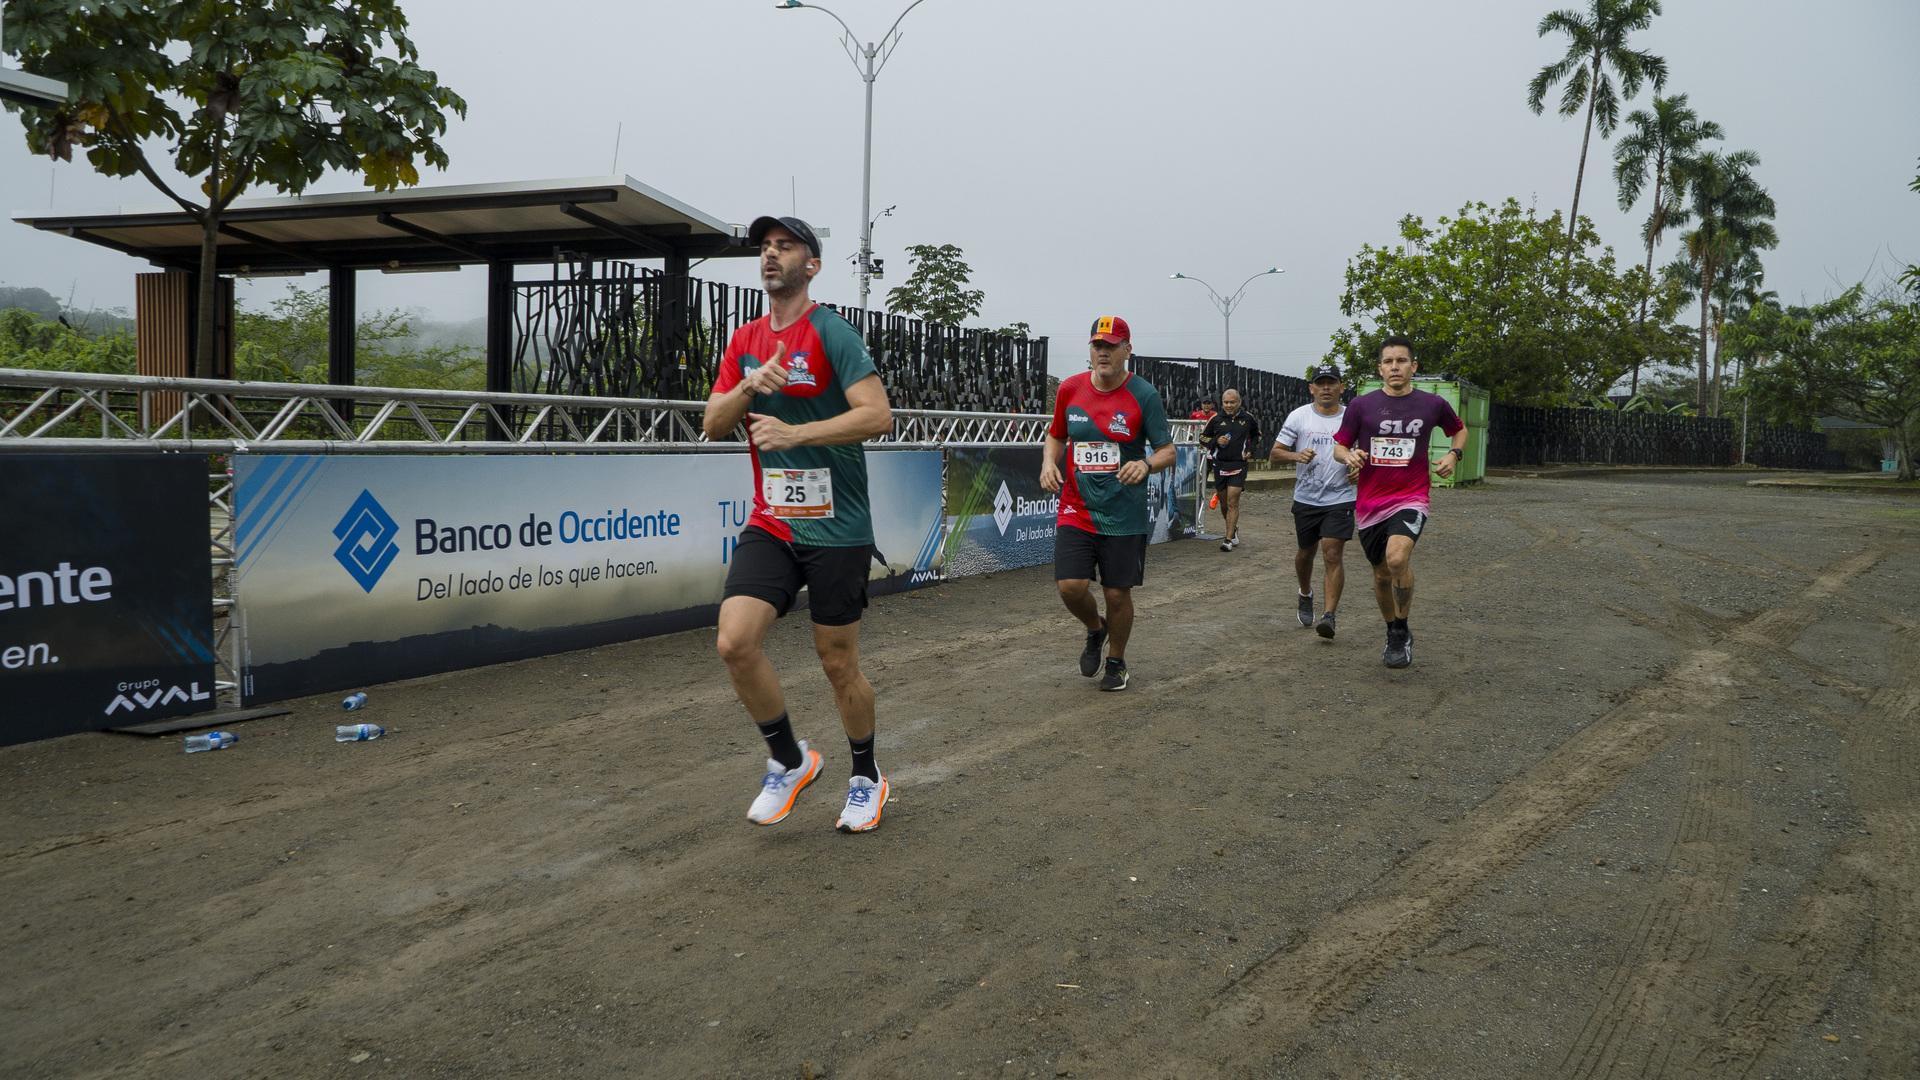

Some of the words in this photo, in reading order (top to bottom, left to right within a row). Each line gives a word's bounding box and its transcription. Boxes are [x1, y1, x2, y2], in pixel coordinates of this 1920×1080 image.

[1085, 452, 1108, 463] 916
[1382, 447, 1403, 457] 743
[785, 486, 806, 503] 25
[1017, 496, 1047, 517] Banco
[1049, 493, 1060, 513] de
[718, 500, 746, 528] TU
[415, 518, 512, 556] Banco
[519, 513, 553, 547] de
[558, 508, 680, 544] Occidente
[1016, 528, 1027, 542] Del
[1029, 526, 1044, 540] lado
[1044, 524, 1053, 537] de
[722, 535, 739, 564] I
[417, 572, 452, 601] Del
[458, 569, 504, 597] lado
[509, 566, 533, 590] de
[538, 563, 564, 587] los
[569, 564, 601, 588] que
[605, 559, 658, 580] hacen.
[911, 569, 939, 583] AVAL
[2, 642, 59, 669] en.
[117, 679, 160, 692] Grupo
[104, 682, 210, 716] AVAL
